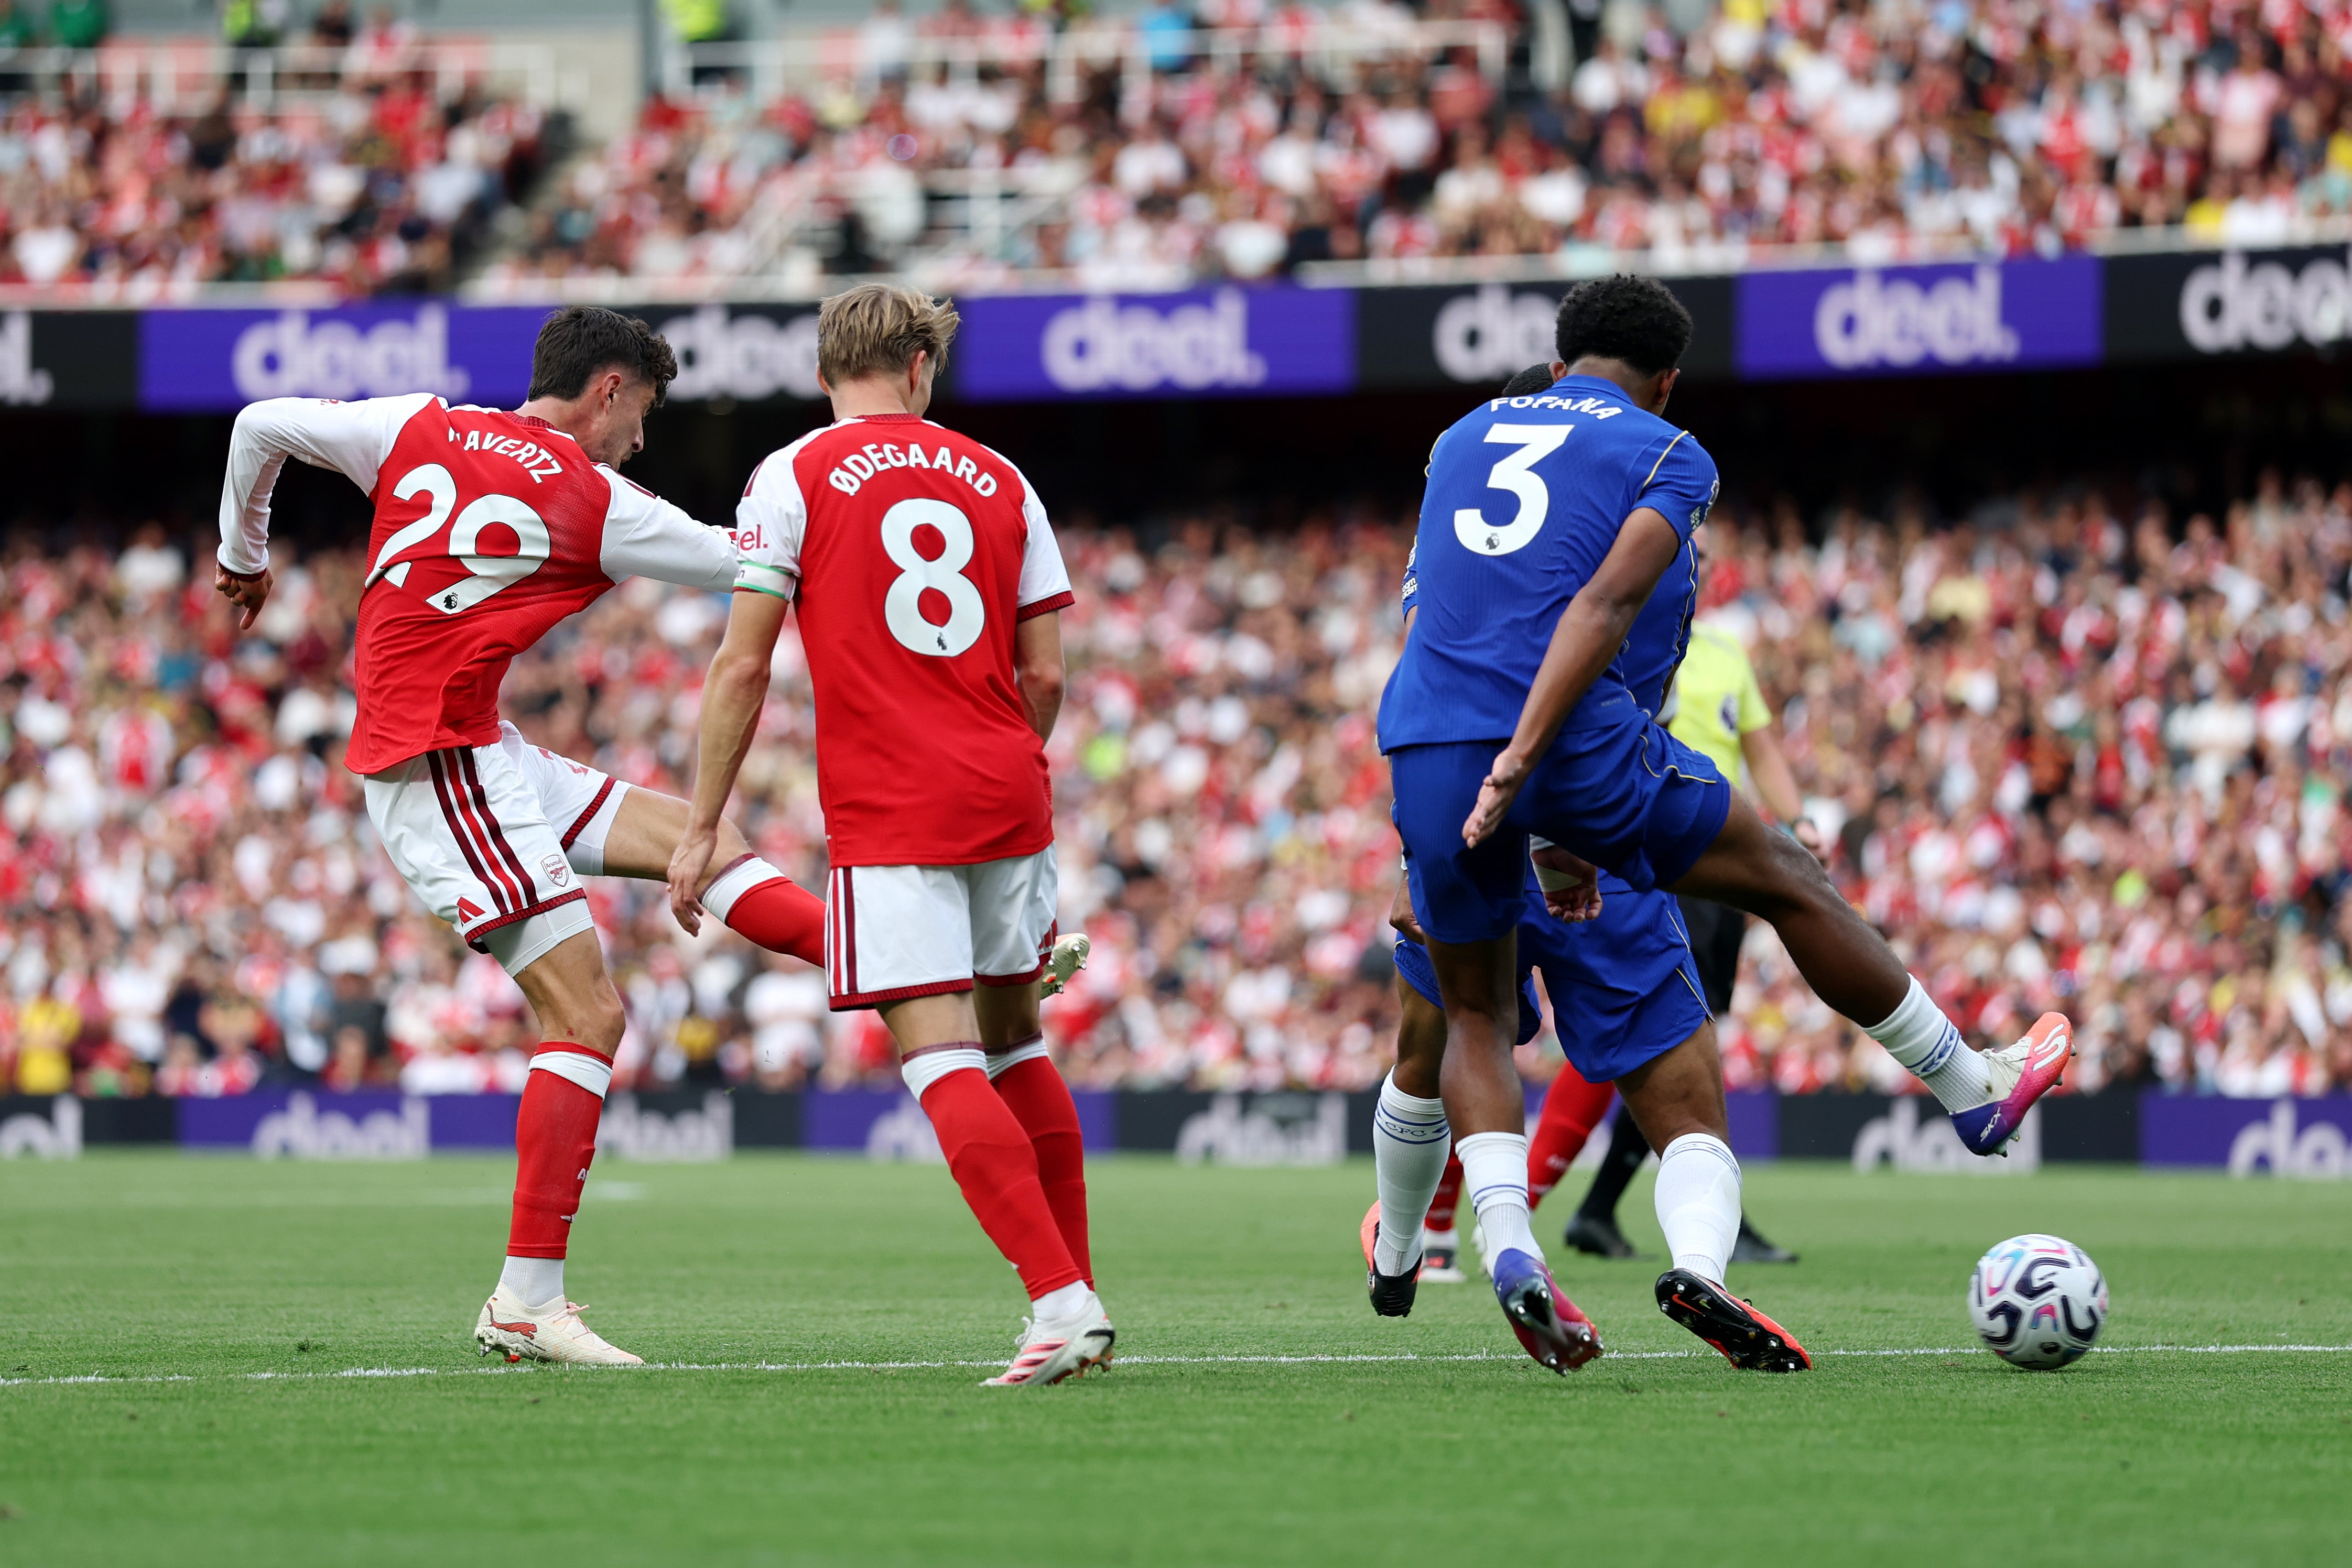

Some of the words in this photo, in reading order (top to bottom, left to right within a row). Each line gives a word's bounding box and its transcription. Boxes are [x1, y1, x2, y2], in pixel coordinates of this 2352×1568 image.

[232, 304, 470, 402] deel.
[656, 306, 819, 401] dee
[1042, 287, 1268, 392] deel.
[1814, 262, 2021, 369] deel.
[2180, 251, 2352, 355] dee
[828, 443, 998, 496] ØDEGAARD
[1454, 423, 1575, 557] 3
[365, 463, 551, 615] 29
[739, 524, 768, 551] el.
[881, 498, 985, 658] 8
[1385, 1121, 1426, 1137] CFC
[1980, 1106, 2001, 1142] SKX
